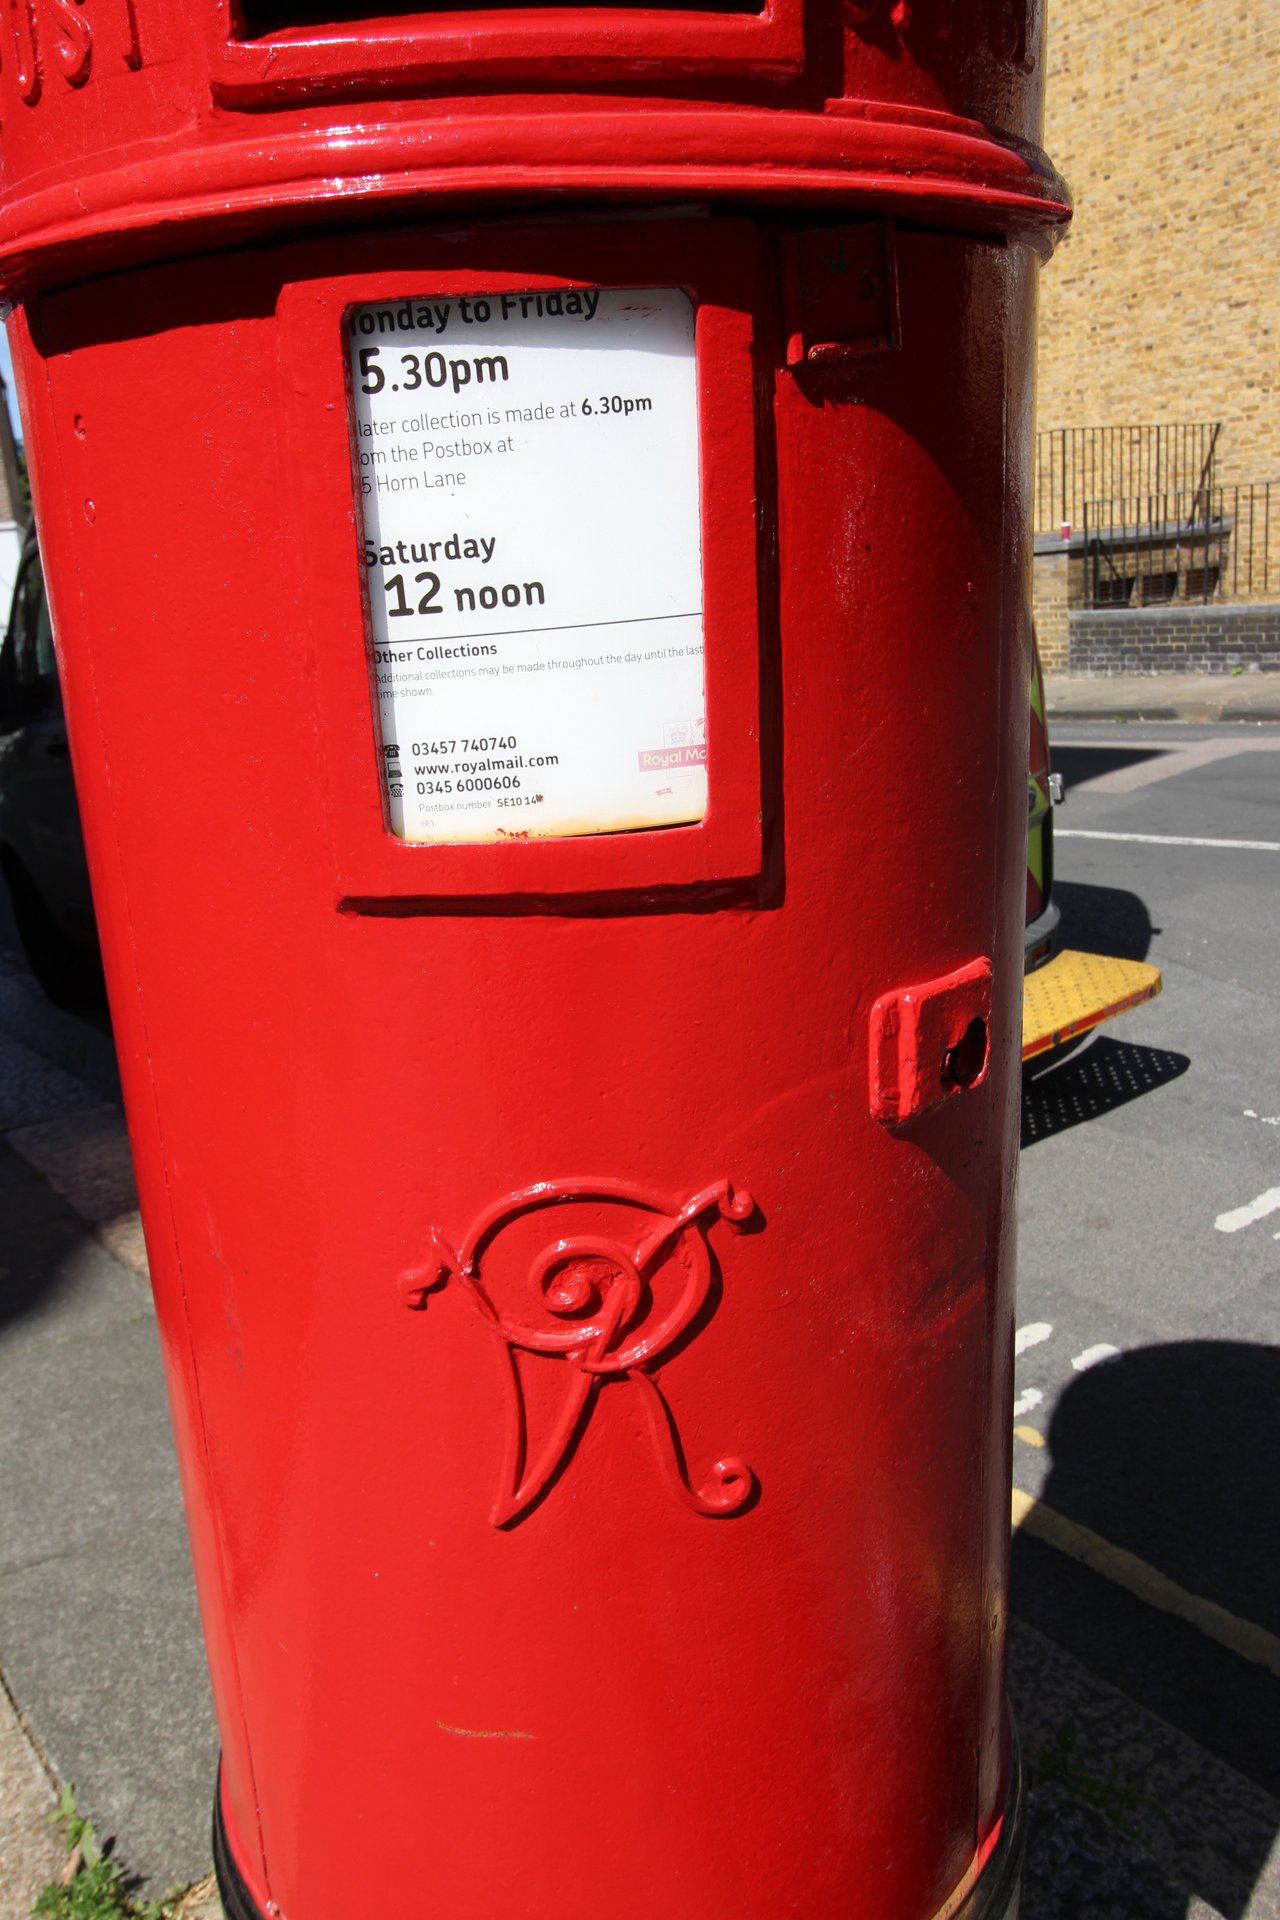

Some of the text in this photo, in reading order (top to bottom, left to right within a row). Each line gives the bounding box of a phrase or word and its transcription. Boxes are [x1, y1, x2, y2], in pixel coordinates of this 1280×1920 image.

[459, 298, 491, 323] to
[359, 347, 509, 394] 5.30pm
[358, 395, 652, 437] later collection is made at 6.30pm
[360, 435, 515, 466] om the Postbox at
[376, 474, 419, 492] Horn
[423, 470, 466, 488] Lane
[365, 533, 496, 568] Saturday
[384, 571, 546, 617] 12 noon
[374, 643, 498, 665] Other Collections
[425, 666, 477, 681] collections
[479, 666, 500, 677] may
[502, 664, 515, 674] be
[517, 660, 545, 672] made
[547, 656, 604, 670] throughout
[606, 653, 623, 665] the
[624, 652, 642, 664] day
[644, 648, 667, 660] until
[668, 647, 684, 658] the
[686, 645, 704, 656] last
[412, 735, 517, 756] 03457 740740
[642, 747, 706, 767] Royal Ma
[414, 755, 559, 775] www.royalmail.com
[416, 775, 521, 795] 0345 6000606
[419, 803, 455, 814] Postbox
[456, 799, 492, 811] number
[497, 796, 522, 808] SE10
